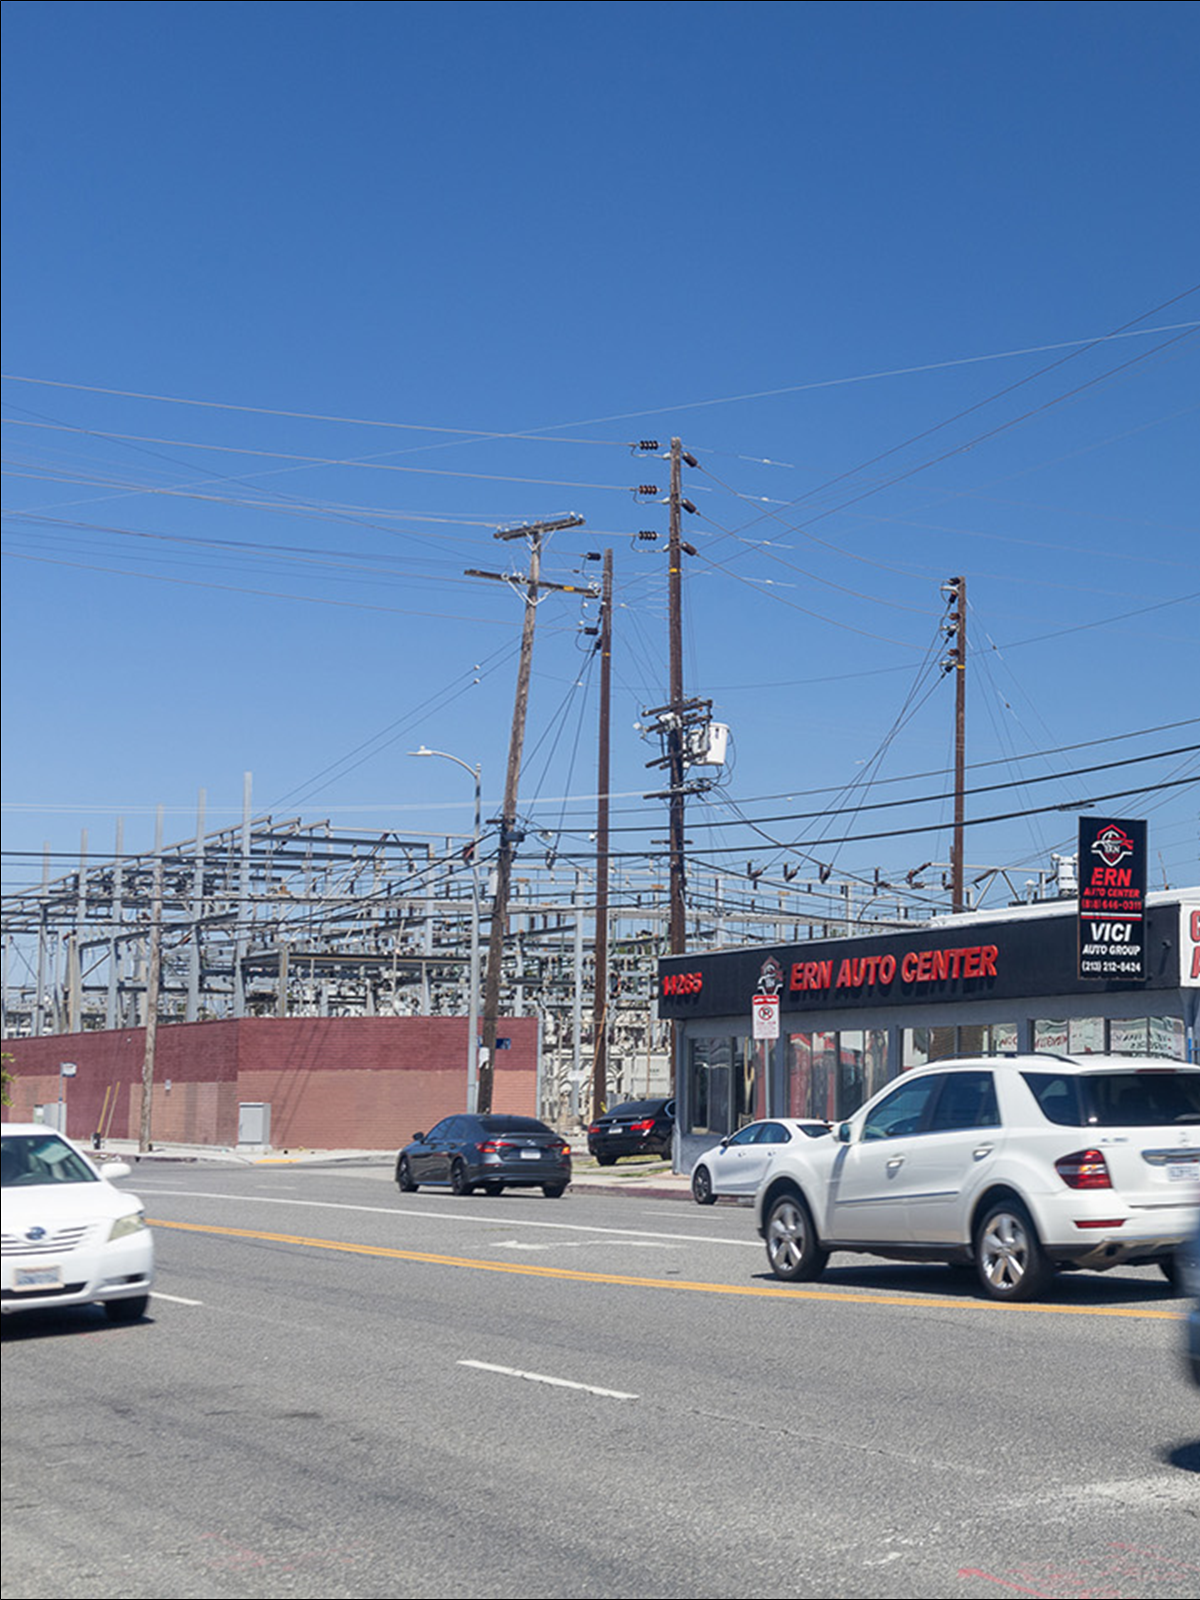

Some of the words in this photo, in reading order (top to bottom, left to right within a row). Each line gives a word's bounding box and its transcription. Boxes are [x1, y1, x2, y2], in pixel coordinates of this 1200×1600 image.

[1091, 867, 1132, 887] ERN
[1083, 887, 1106, 897] AUTO
[1107, 888, 1140, 898] CENTER
[1090, 922, 1132, 943] VICI
[1082, 944, 1108, 956] AUTO
[1109, 945, 1141, 956] GROUP
[789, 959, 834, 991] ERN
[835, 954, 897, 988] AUTO
[901, 944, 998, 983] CENTER
